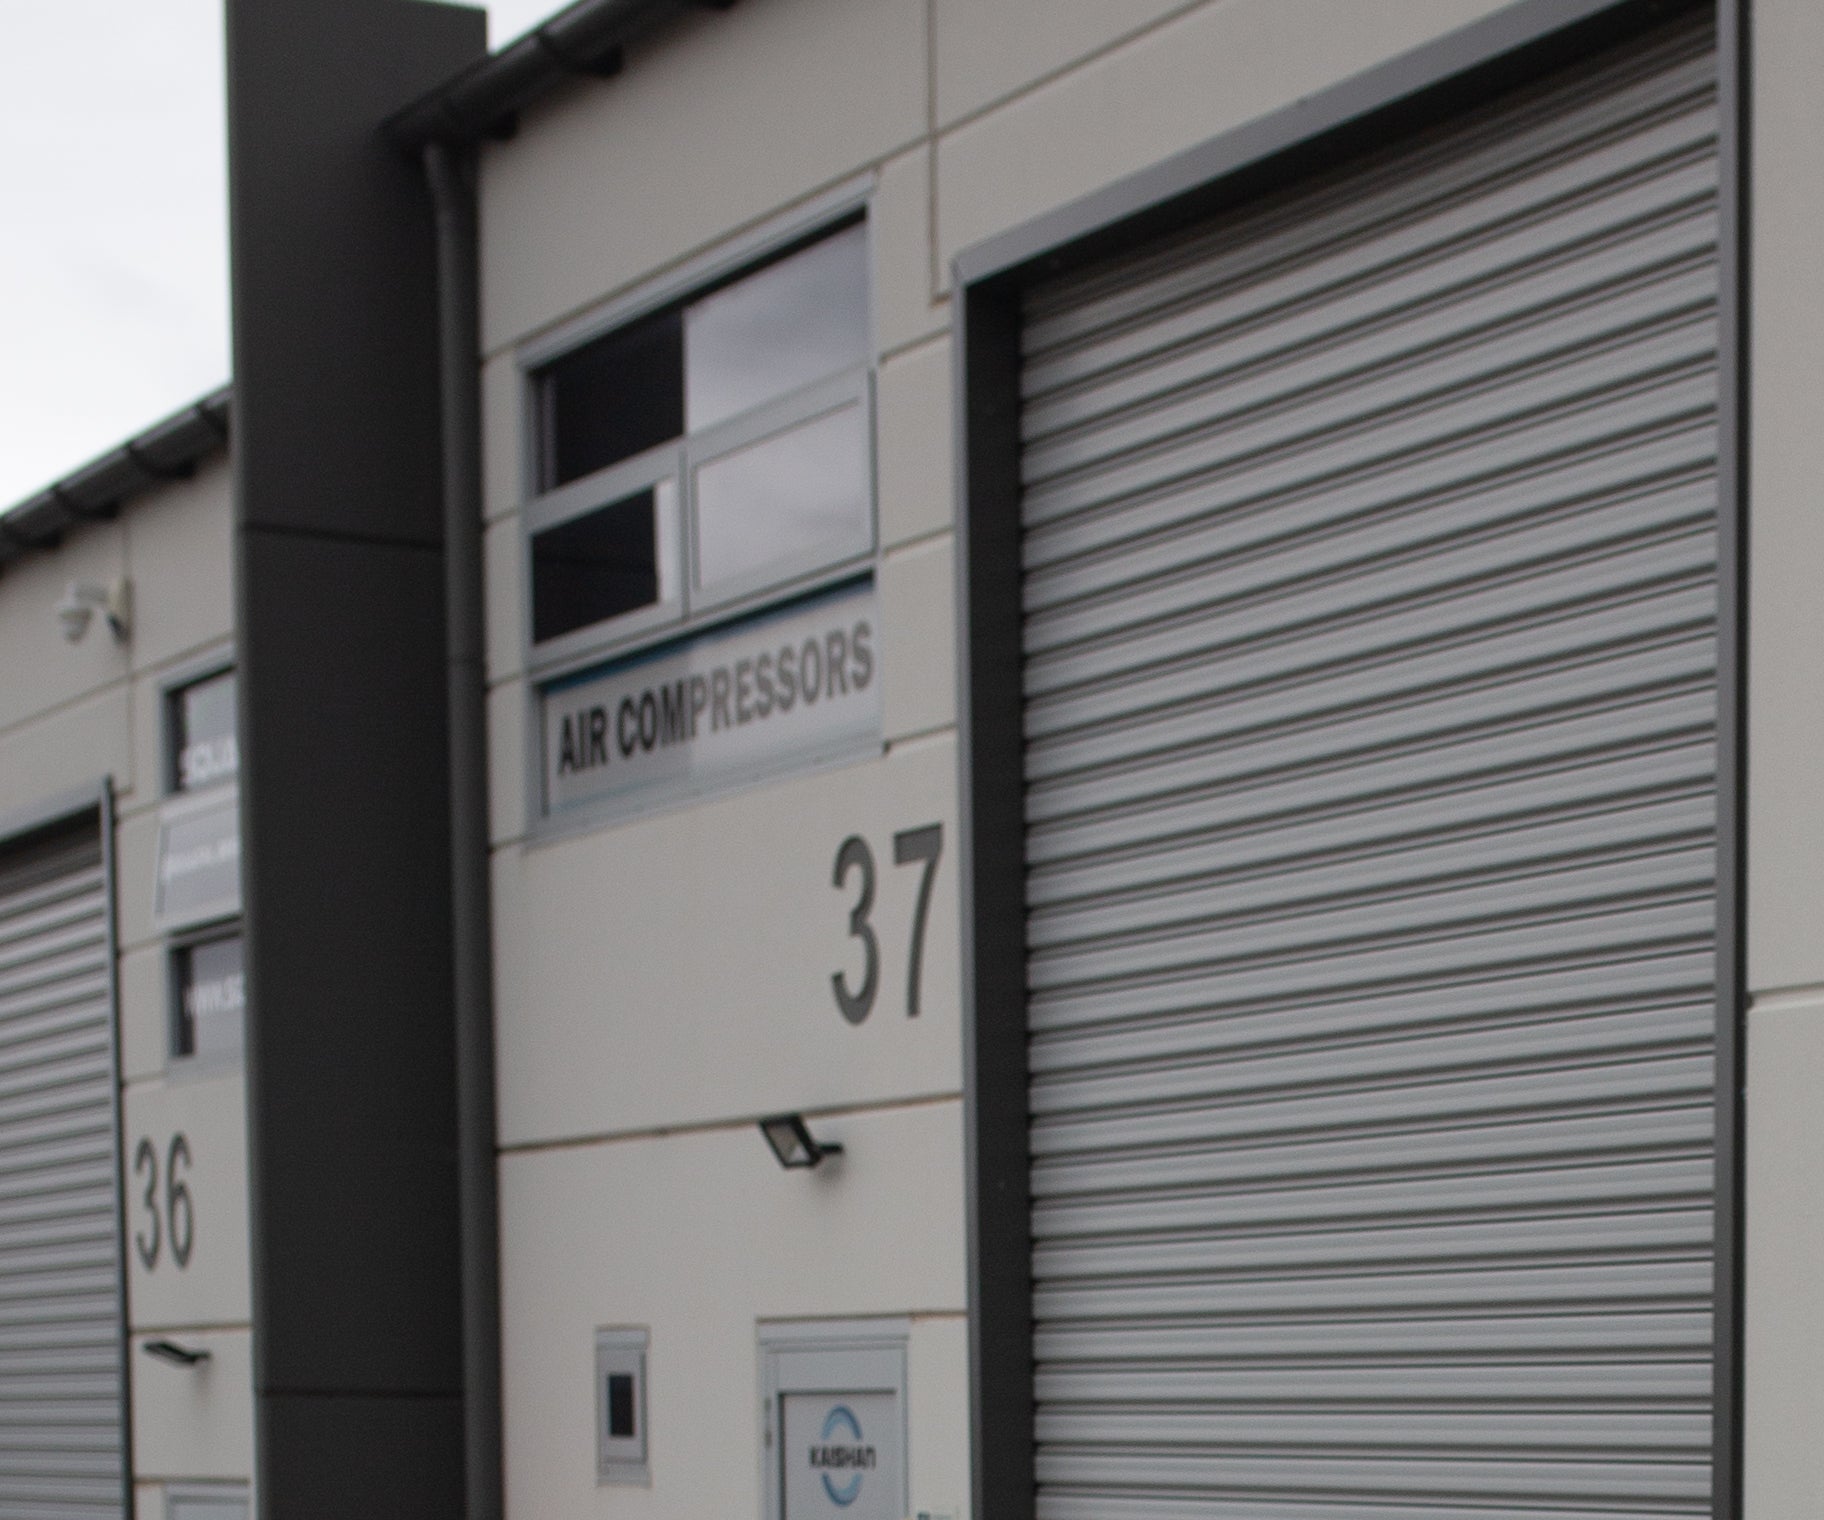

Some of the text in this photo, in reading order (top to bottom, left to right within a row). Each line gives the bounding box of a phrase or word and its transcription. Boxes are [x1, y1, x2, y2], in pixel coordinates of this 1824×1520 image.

[558, 620, 876, 777] AIR COMPRESSORS
[829, 821, 944, 1029] 37
[134, 1132, 195, 1274] 36
